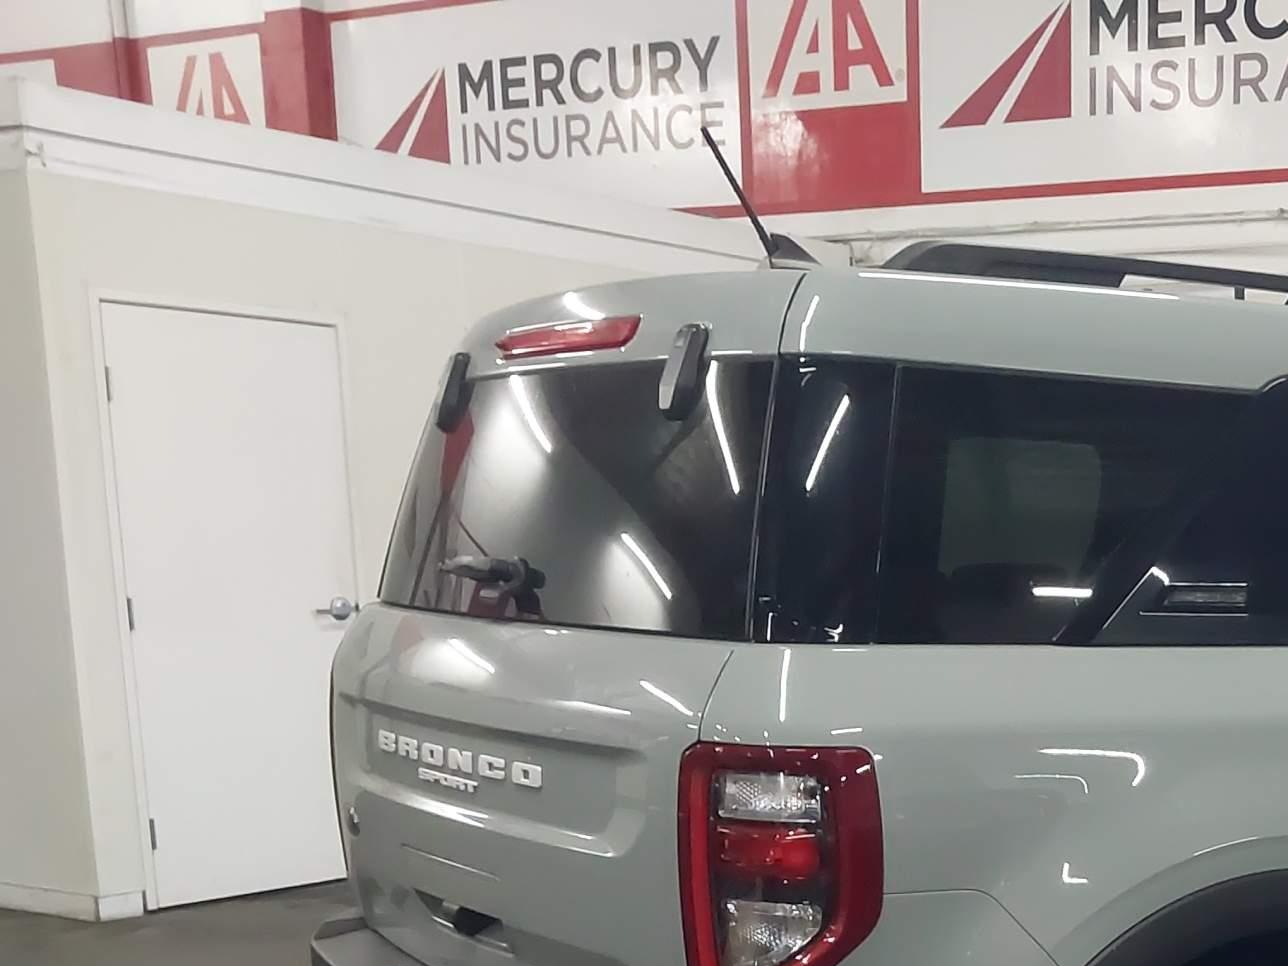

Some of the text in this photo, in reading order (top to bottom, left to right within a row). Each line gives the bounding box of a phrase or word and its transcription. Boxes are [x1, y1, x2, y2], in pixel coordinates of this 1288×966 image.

[457, 35, 720, 114] MERCURY
[461, 101, 726, 166] INSURANCE
[378, 729, 542, 788] BRONCO
[418, 767, 479, 793] SPORT
